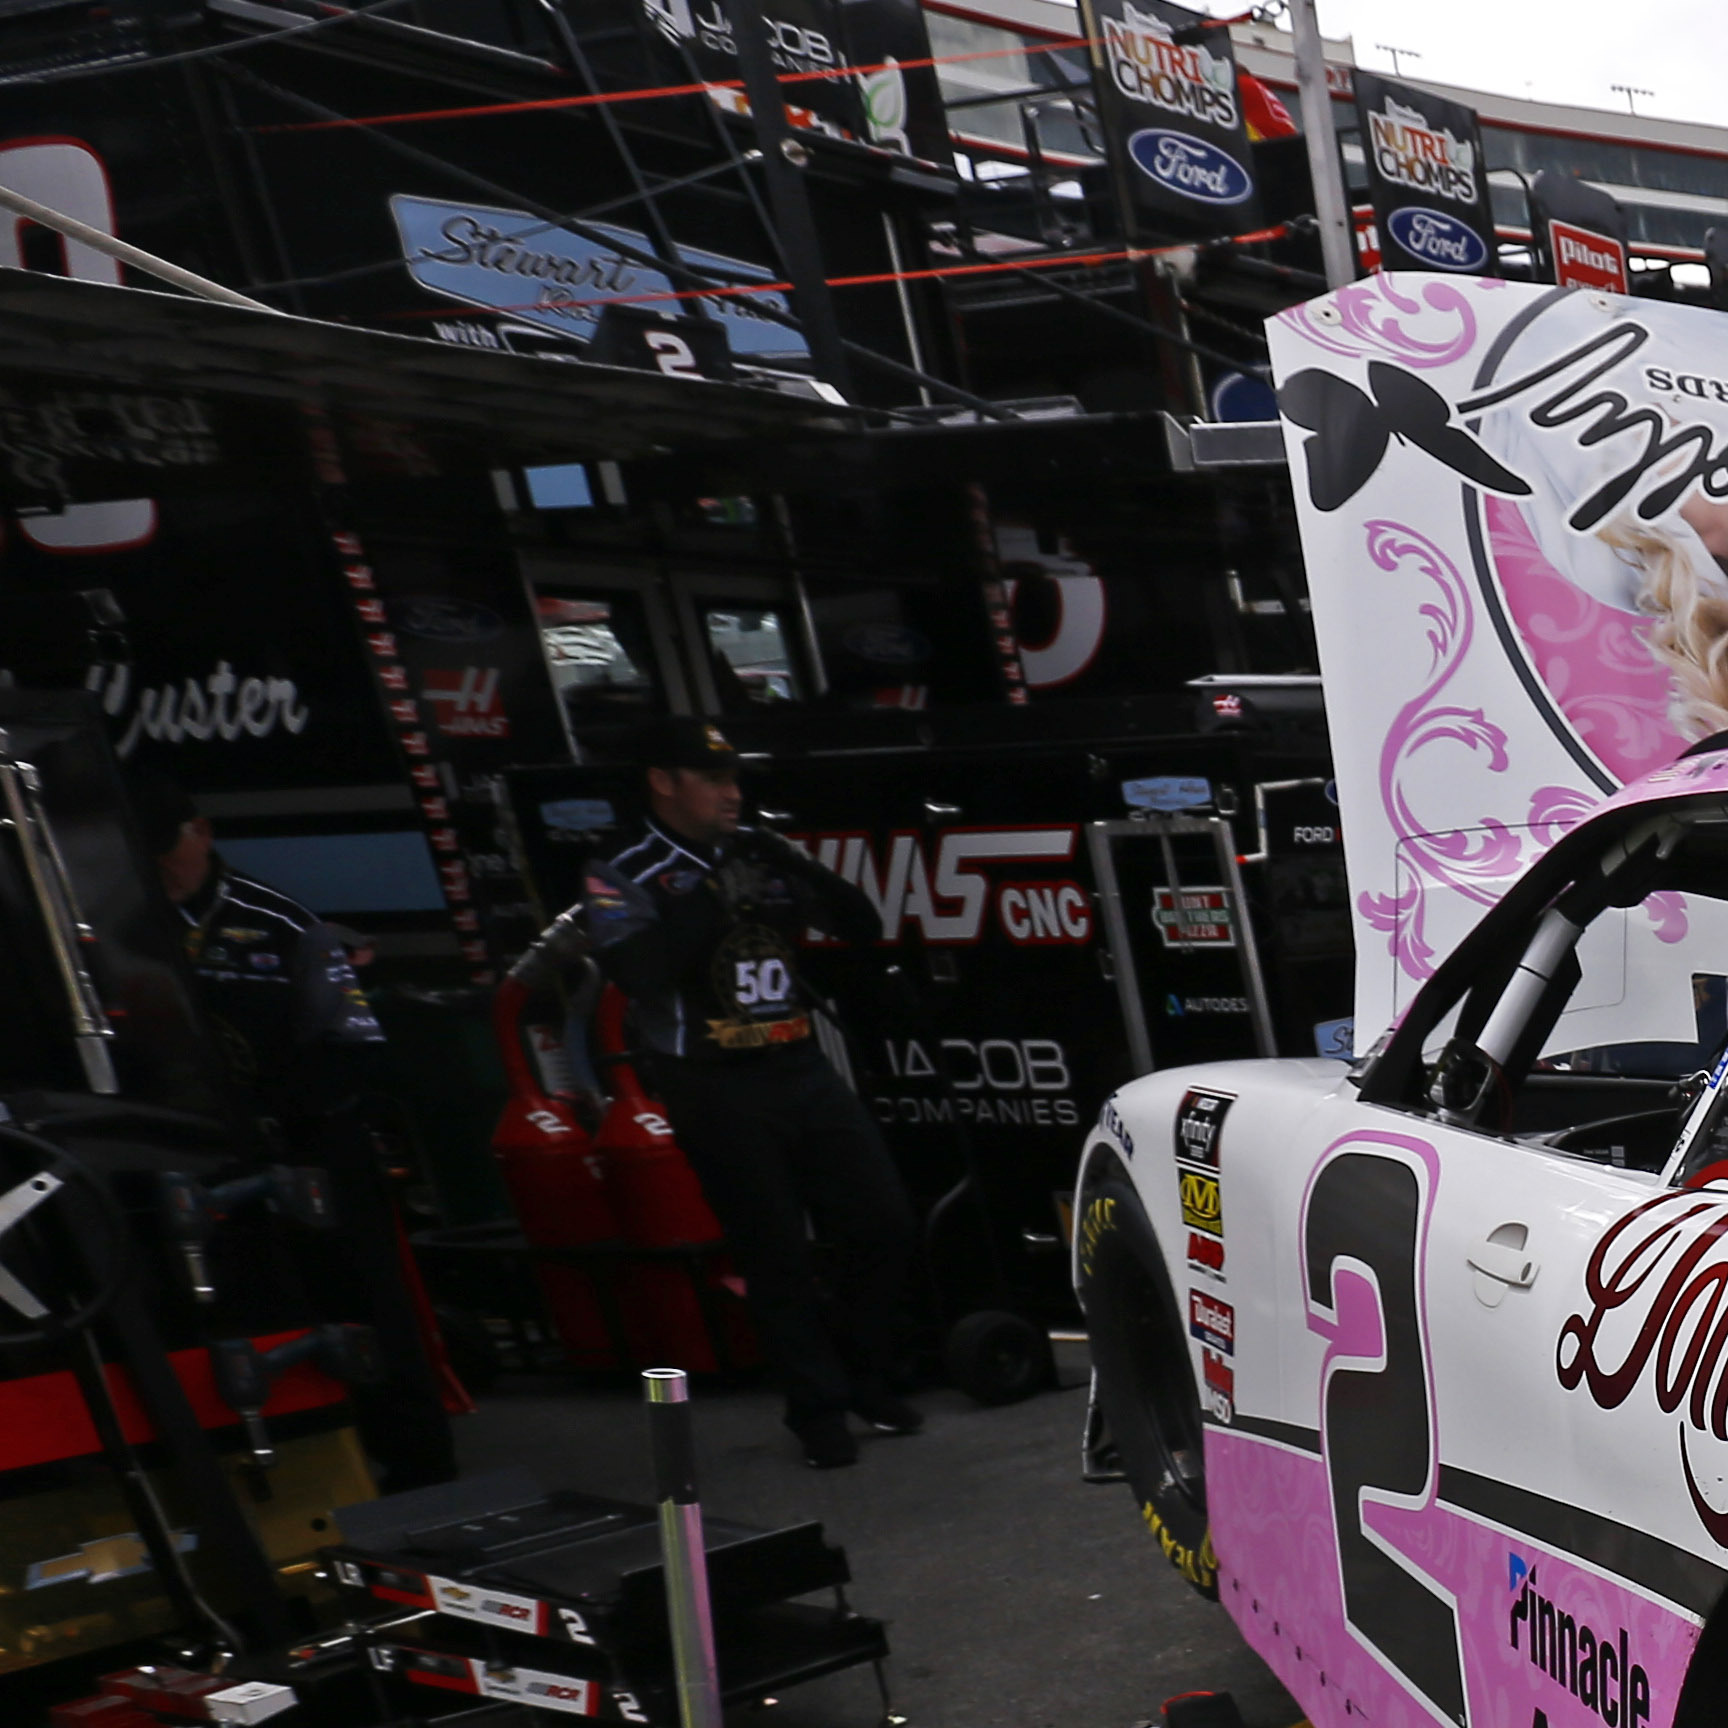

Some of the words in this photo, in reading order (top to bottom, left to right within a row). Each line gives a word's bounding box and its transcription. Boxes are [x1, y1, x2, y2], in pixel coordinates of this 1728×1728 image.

[1108, 24, 1202, 84] NUTRI
[1114, 59, 1236, 127] CHOMPS
[1155, 137, 1229, 192] Ford
[1373, 118, 1450, 166] NUTRI
[1378, 146, 1477, 201] CHOMPS
[1409, 214, 1468, 263] Ford
[433, 321, 499, 350] with
[646, 331, 703, 380] 2
[1294, 826, 1332, 844] FORD
[997, 880, 1094, 946] CNC
[735, 958, 791, 1005] 50
[1184, 996, 1250, 1014] AUTODES
[333, 1561, 365, 1588] LR
[558, 1608, 597, 1645] 2
[613, 1691, 649, 1723] 2
